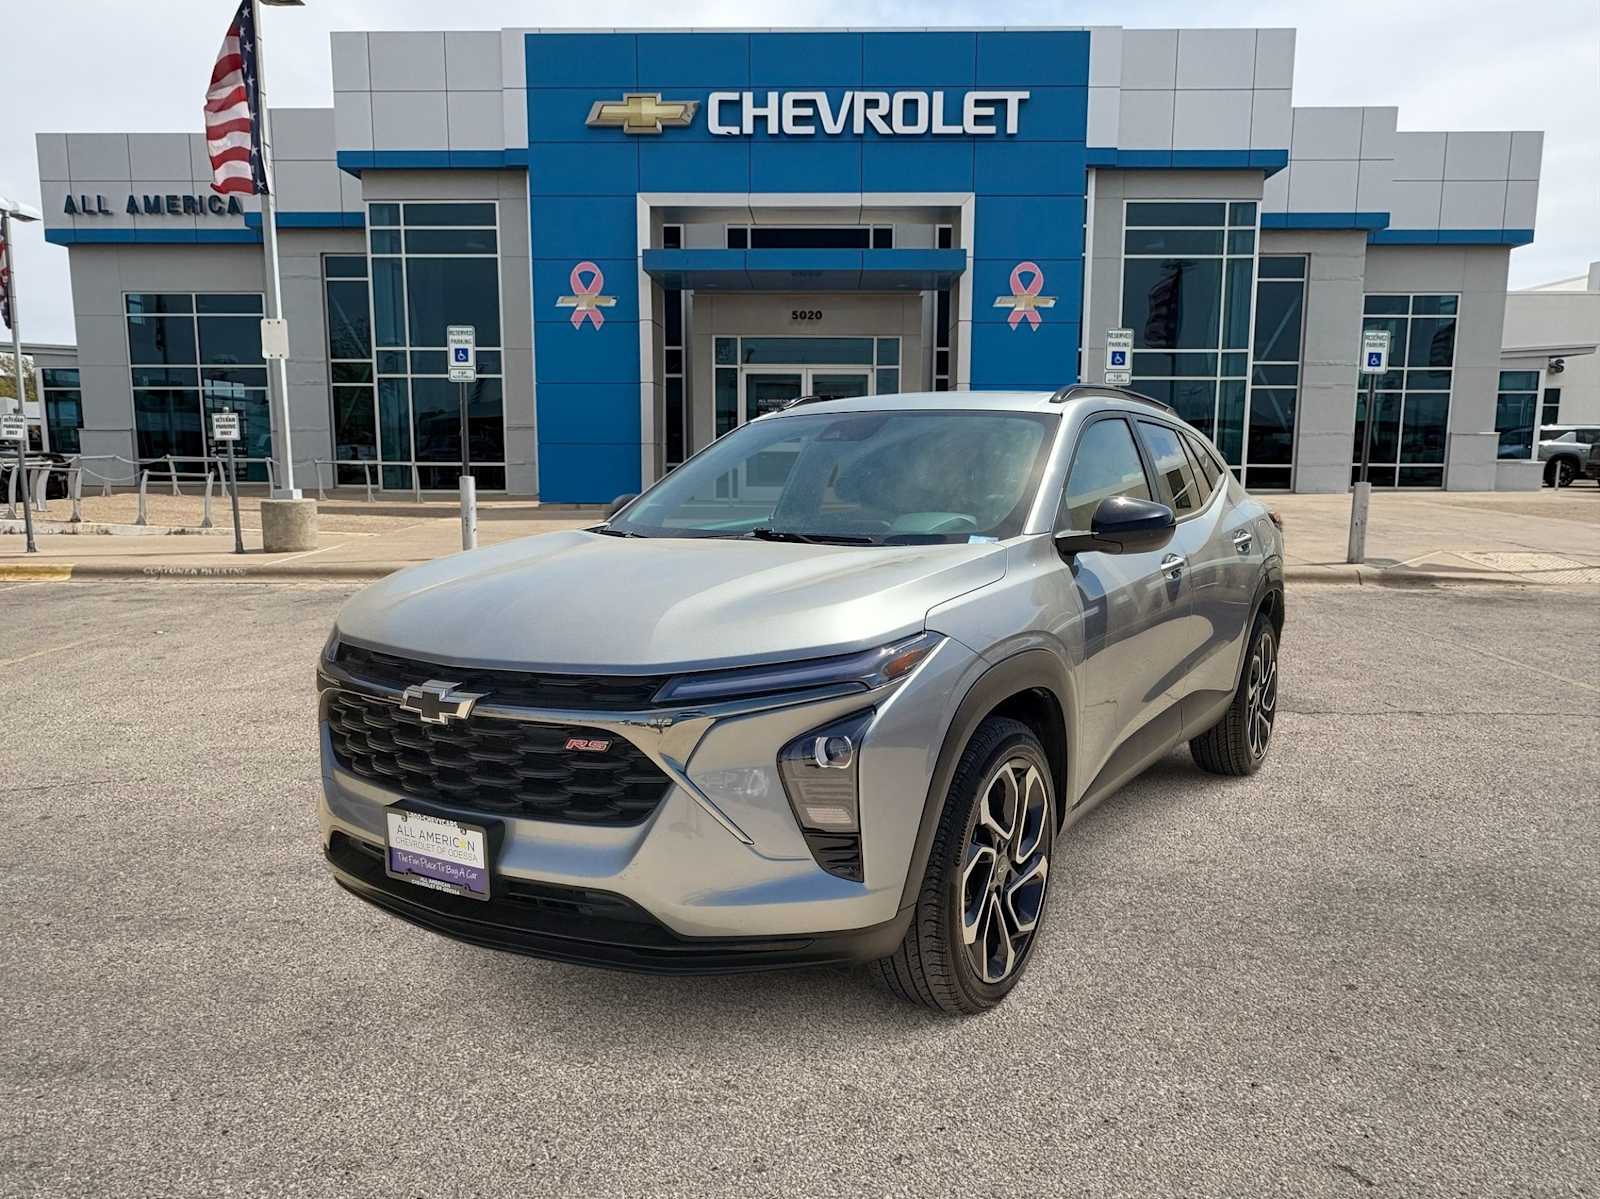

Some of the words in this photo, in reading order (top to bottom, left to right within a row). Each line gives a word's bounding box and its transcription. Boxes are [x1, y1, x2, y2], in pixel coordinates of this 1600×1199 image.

[707, 91, 1031, 135] CHEVROLET
[64, 195, 113, 216] ALL
[791, 310, 823, 321] 5020
[565, 738, 609, 752] RS
[397, 825, 416, 838] ALL
[396, 837, 436, 851] CHEVROLET
[447, 848, 478, 863] ODESSA
